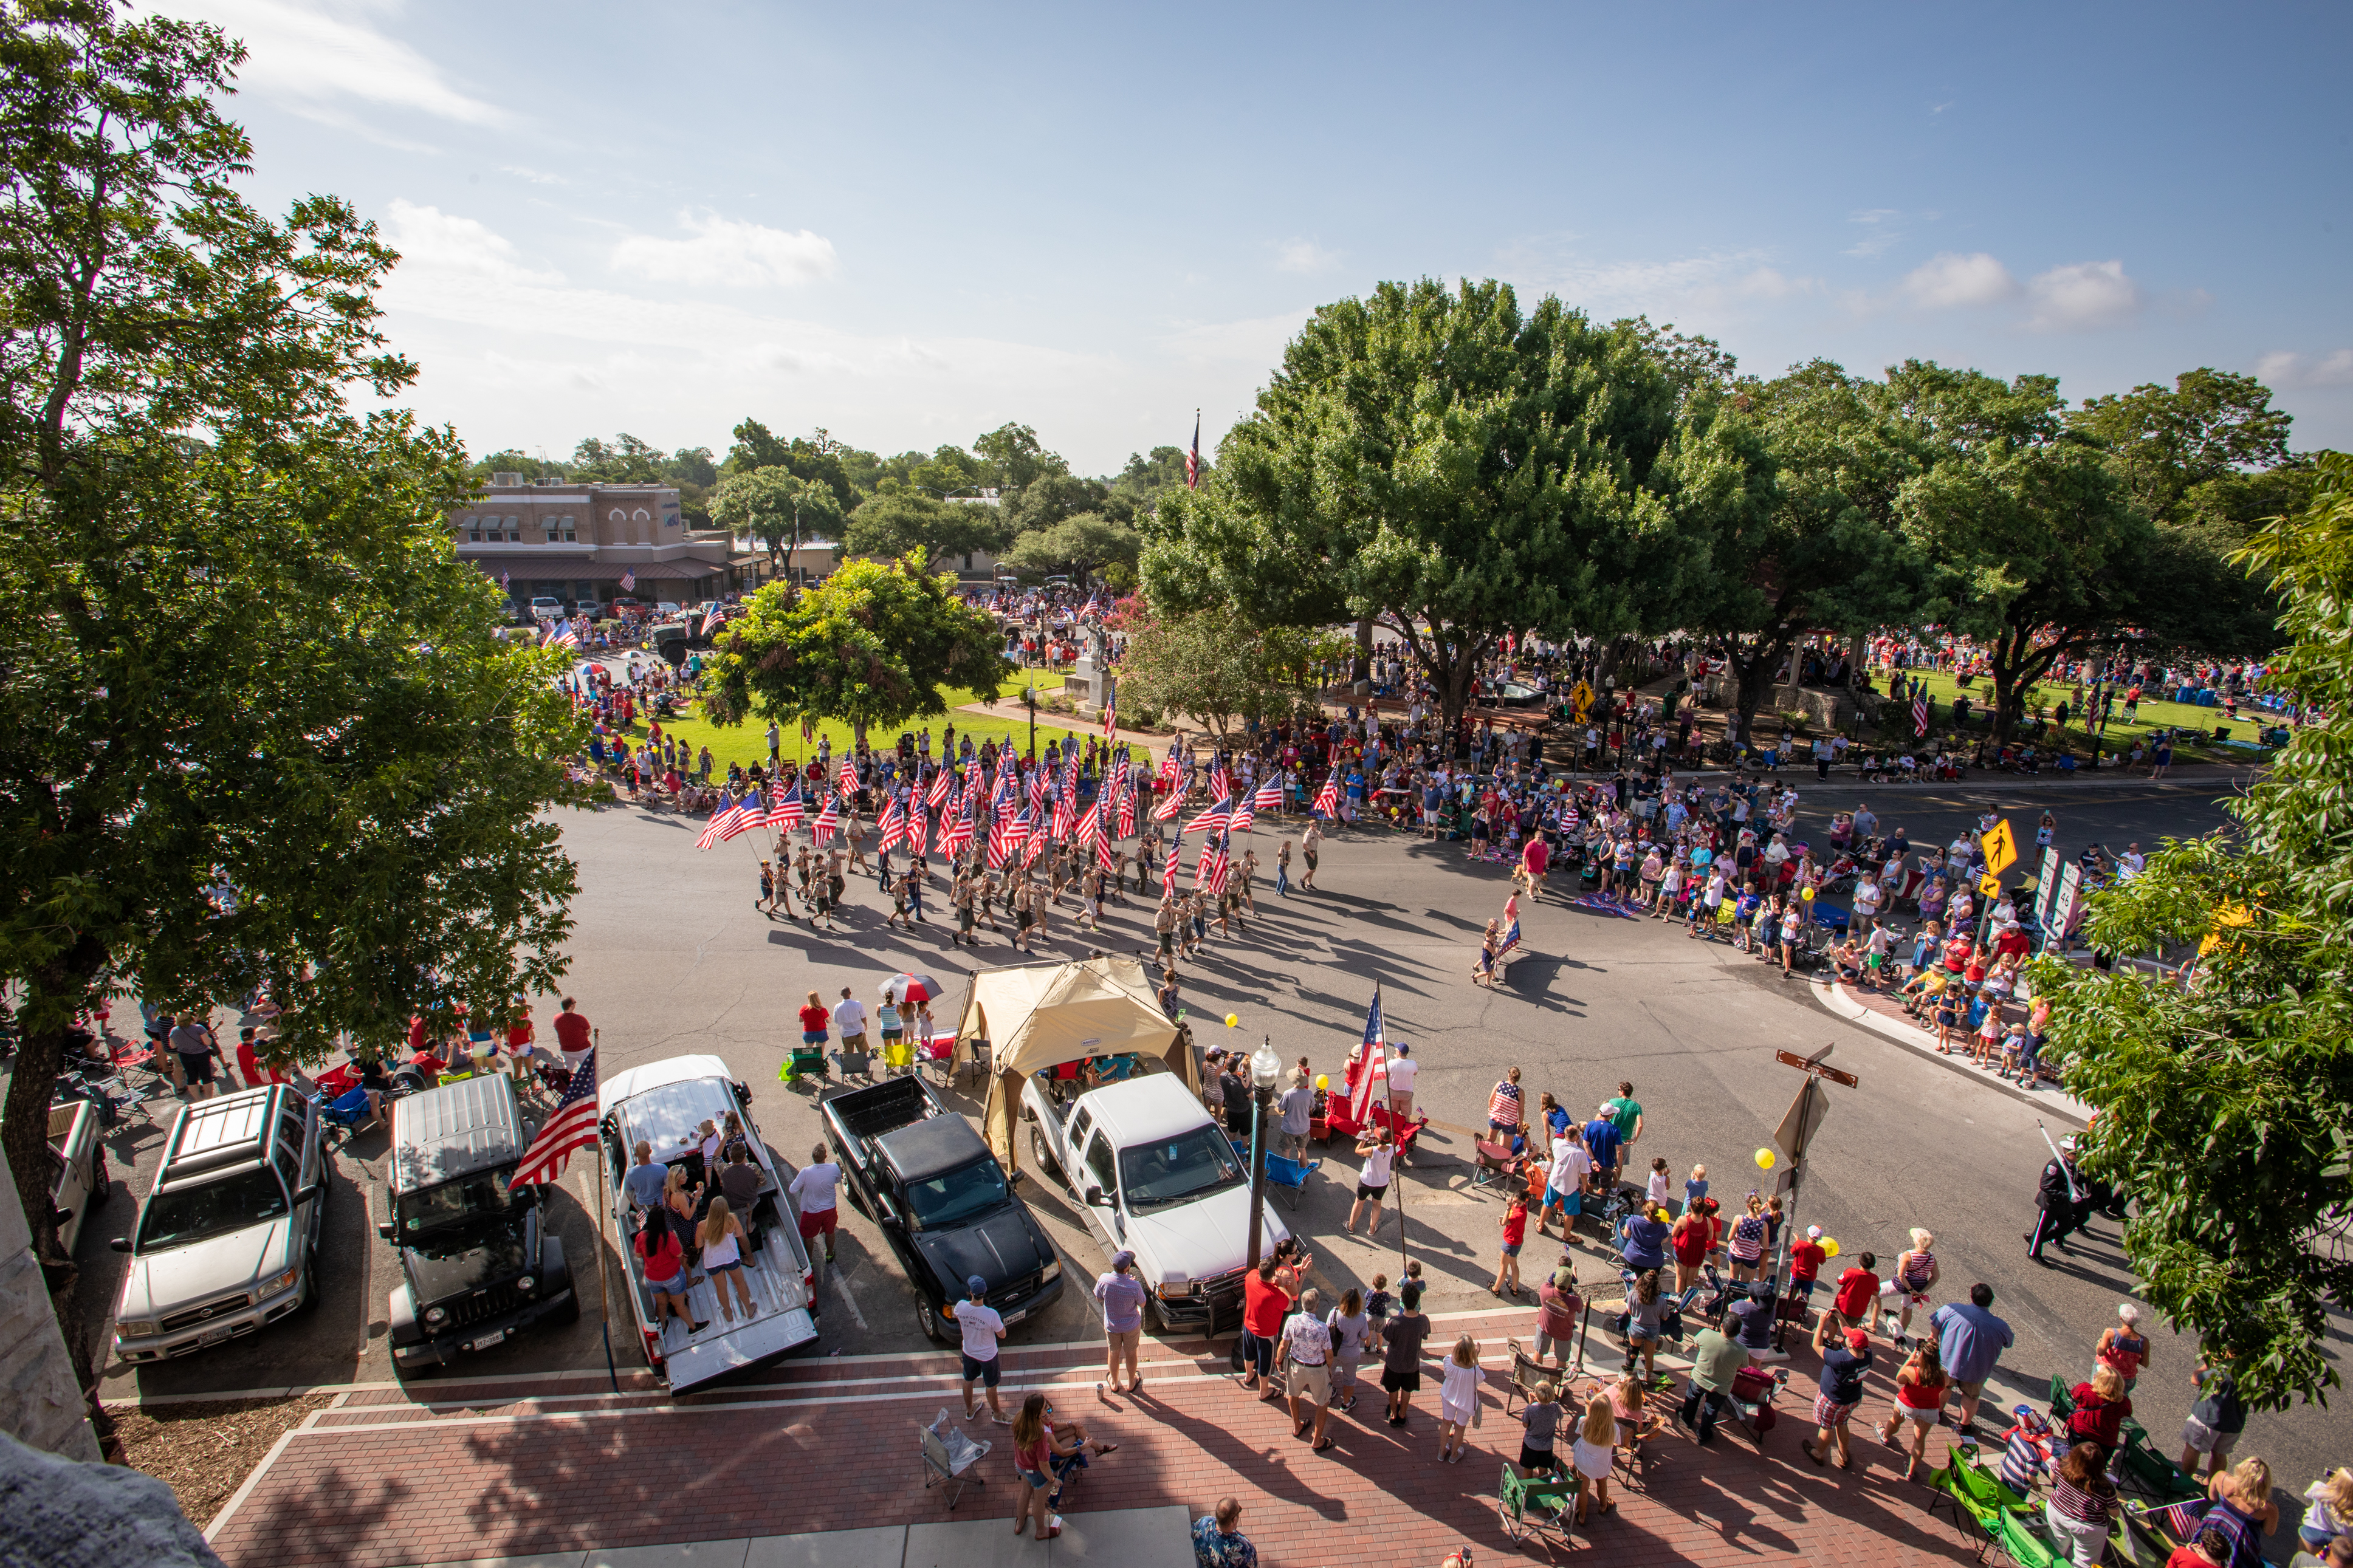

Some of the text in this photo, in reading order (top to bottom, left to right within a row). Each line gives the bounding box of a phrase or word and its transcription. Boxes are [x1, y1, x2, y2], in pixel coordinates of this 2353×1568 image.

[2047, 851, 2056, 864] EAST
[2066, 866, 2077, 881] WEST
[2042, 876, 2049, 890] 46
[2060, 892, 2069, 907] 46
[970, 1316, 986, 1325] COTTON
